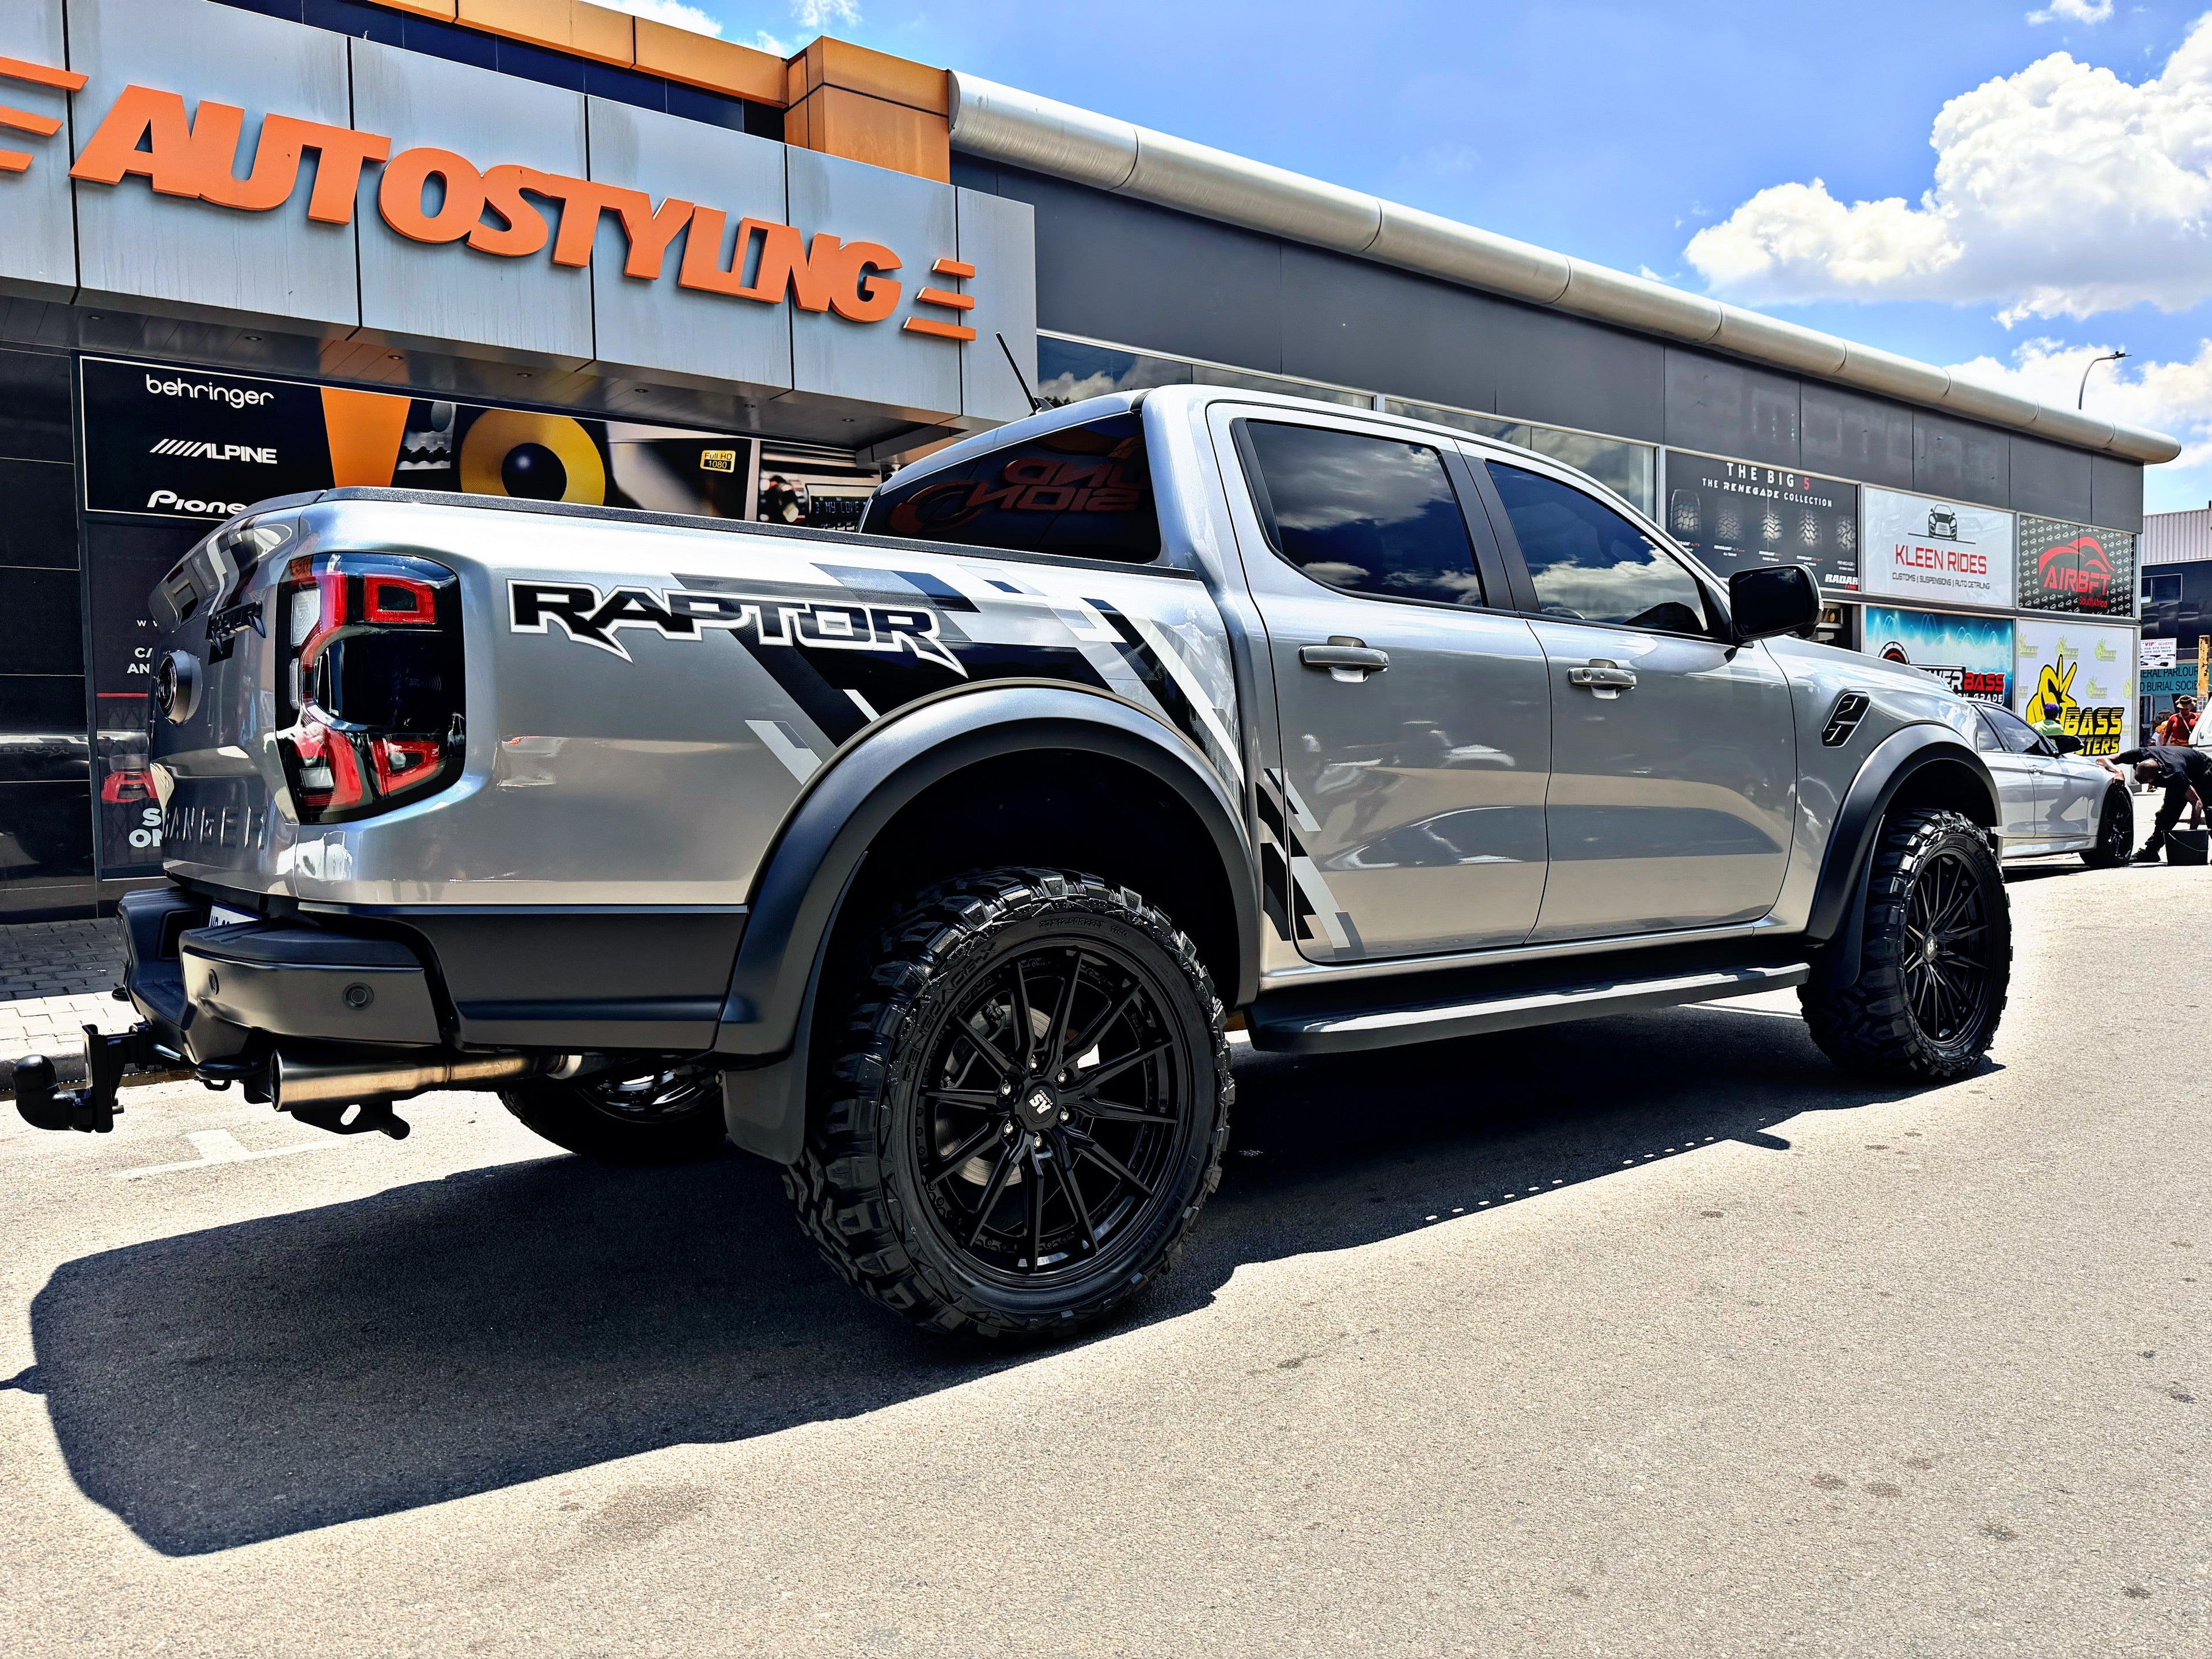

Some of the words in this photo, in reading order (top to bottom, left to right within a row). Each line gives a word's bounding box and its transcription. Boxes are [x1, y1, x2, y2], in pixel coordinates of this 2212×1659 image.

[68, 84, 903, 323] AUTOSTYLING
[146, 374, 274, 408] behringer
[177, 441, 277, 464] ALPINE
[708, 460, 727, 469] 1080
[1726, 462, 1757, 480] THE
[1767, 470, 1794, 487] BIG
[1804, 477, 1809, 490] 5
[1702, 478, 1718, 488] THE
[1723, 482, 1779, 499] RENEGADE
[1784, 492, 1832, 507] COLLECTION
[1895, 544, 1944, 570] KLEEN
[1948, 551, 1987, 575] RIDES
[1825, 573, 1858, 585] RADAR
[1892, 572, 1916, 582] CUSTOMS
[2043, 565, 2111, 596] AIRBFT
[507, 578, 969, 679] RAPTOR
[2164, 666, 2198, 677] PARLOUR
[2147, 681, 2174, 691] BURIAL
[2064, 707, 2124, 736] BASS
